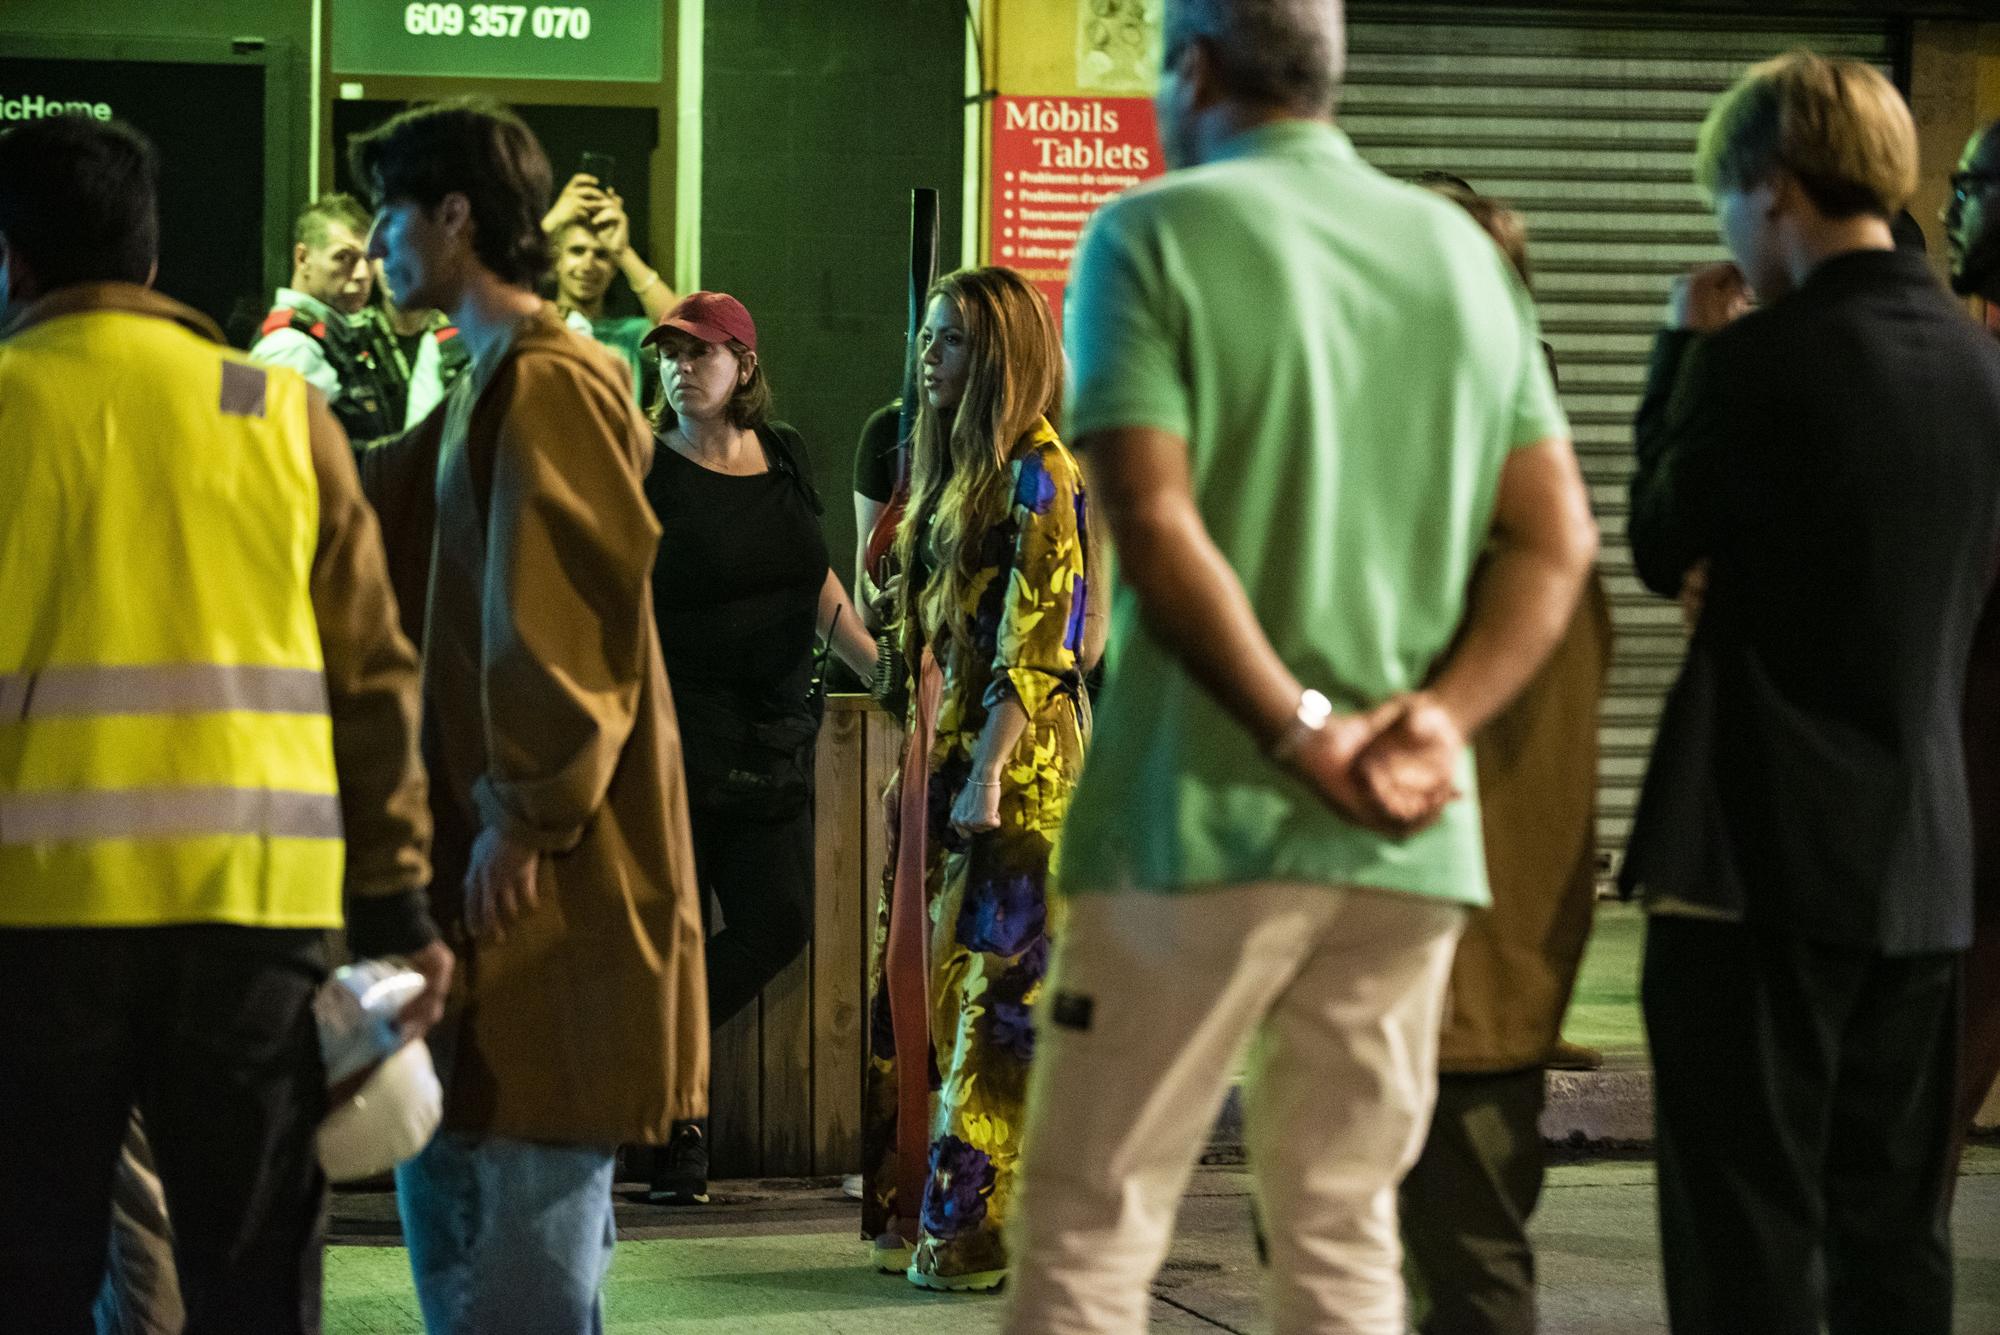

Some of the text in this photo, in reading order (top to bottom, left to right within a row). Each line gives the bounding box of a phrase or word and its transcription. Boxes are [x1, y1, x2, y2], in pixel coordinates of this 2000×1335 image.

[404, 2, 592, 40] 609 357 070
[1004, 100, 1119, 133] Mòbils
[1032, 137, 1150, 170] Tablets
